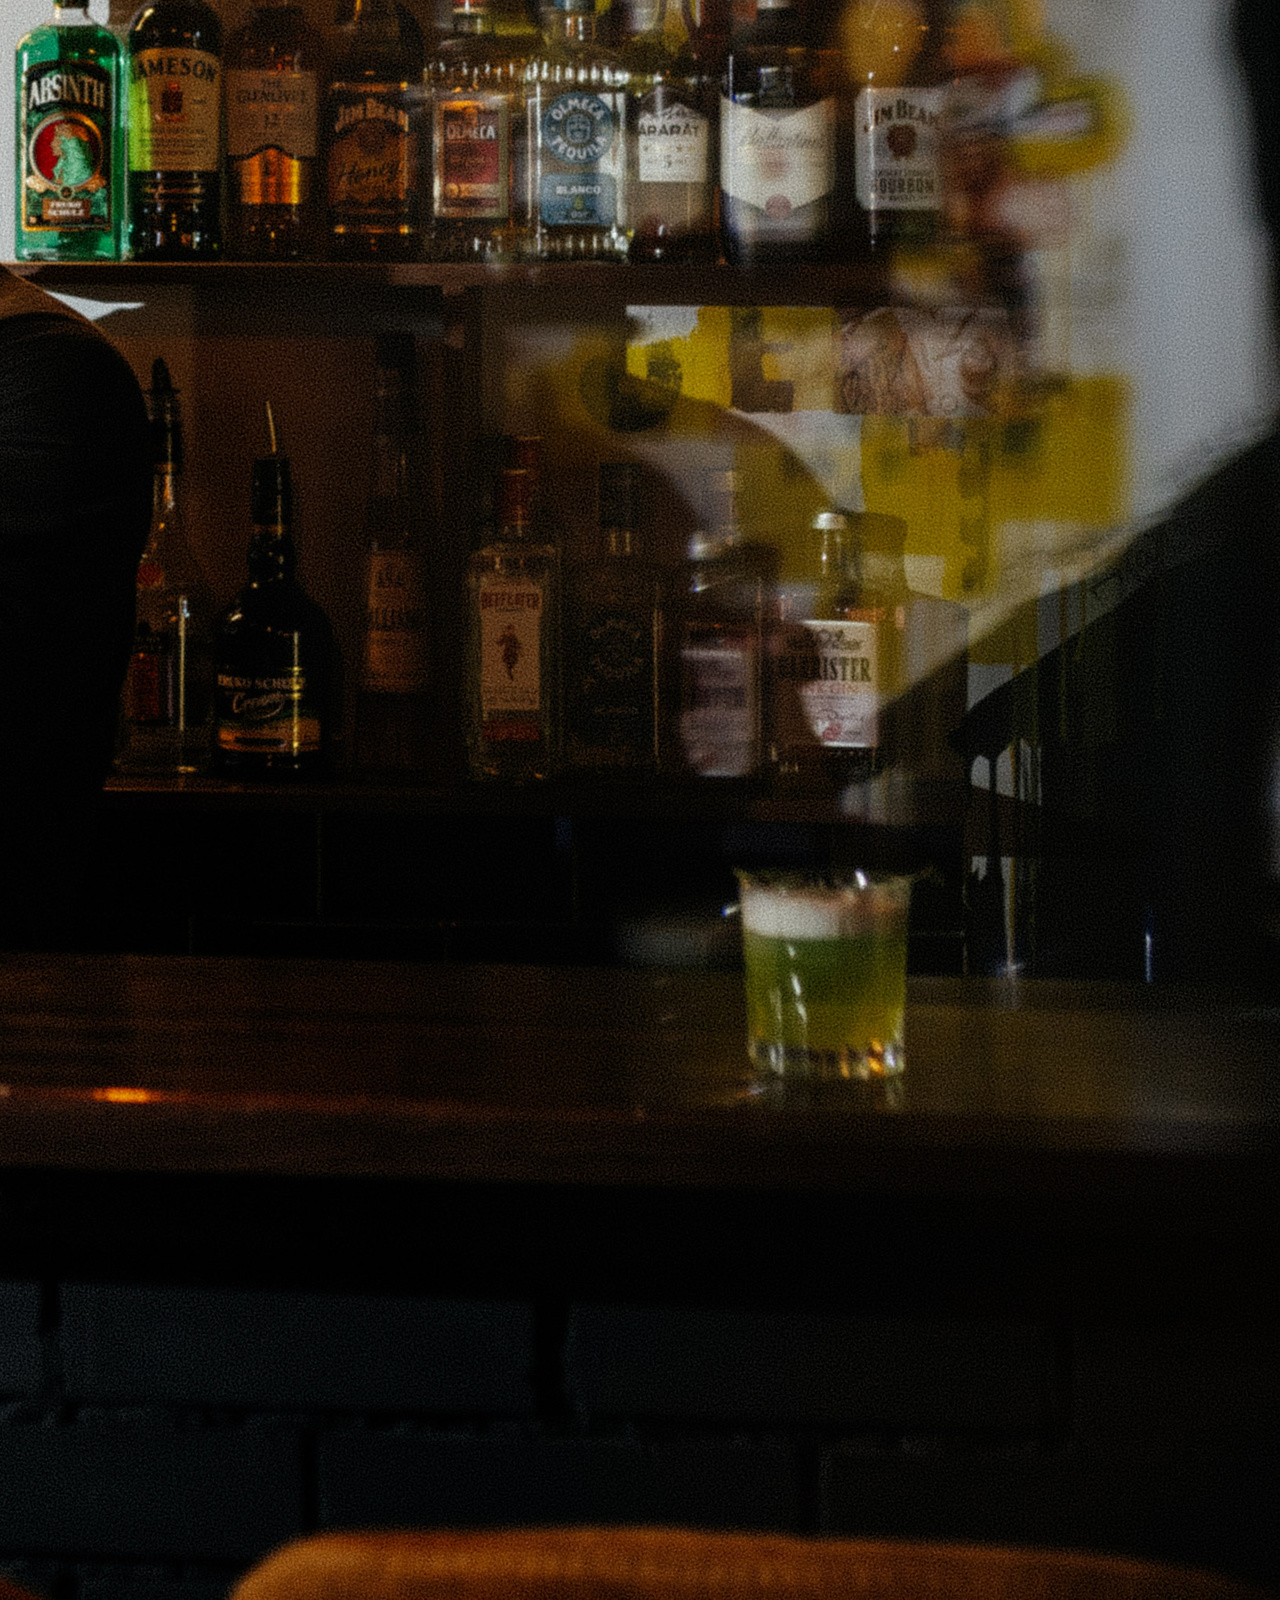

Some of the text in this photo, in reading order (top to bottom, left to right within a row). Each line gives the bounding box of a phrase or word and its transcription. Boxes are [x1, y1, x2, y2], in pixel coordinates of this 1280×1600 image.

[28, 74, 106, 109] ABSINTH
[551, 98, 605, 121] OLMECA
[638, 123, 699, 137] ARARAT
[550, 135, 607, 160] TEQUILA
[555, 185, 601, 195] BLANCO
